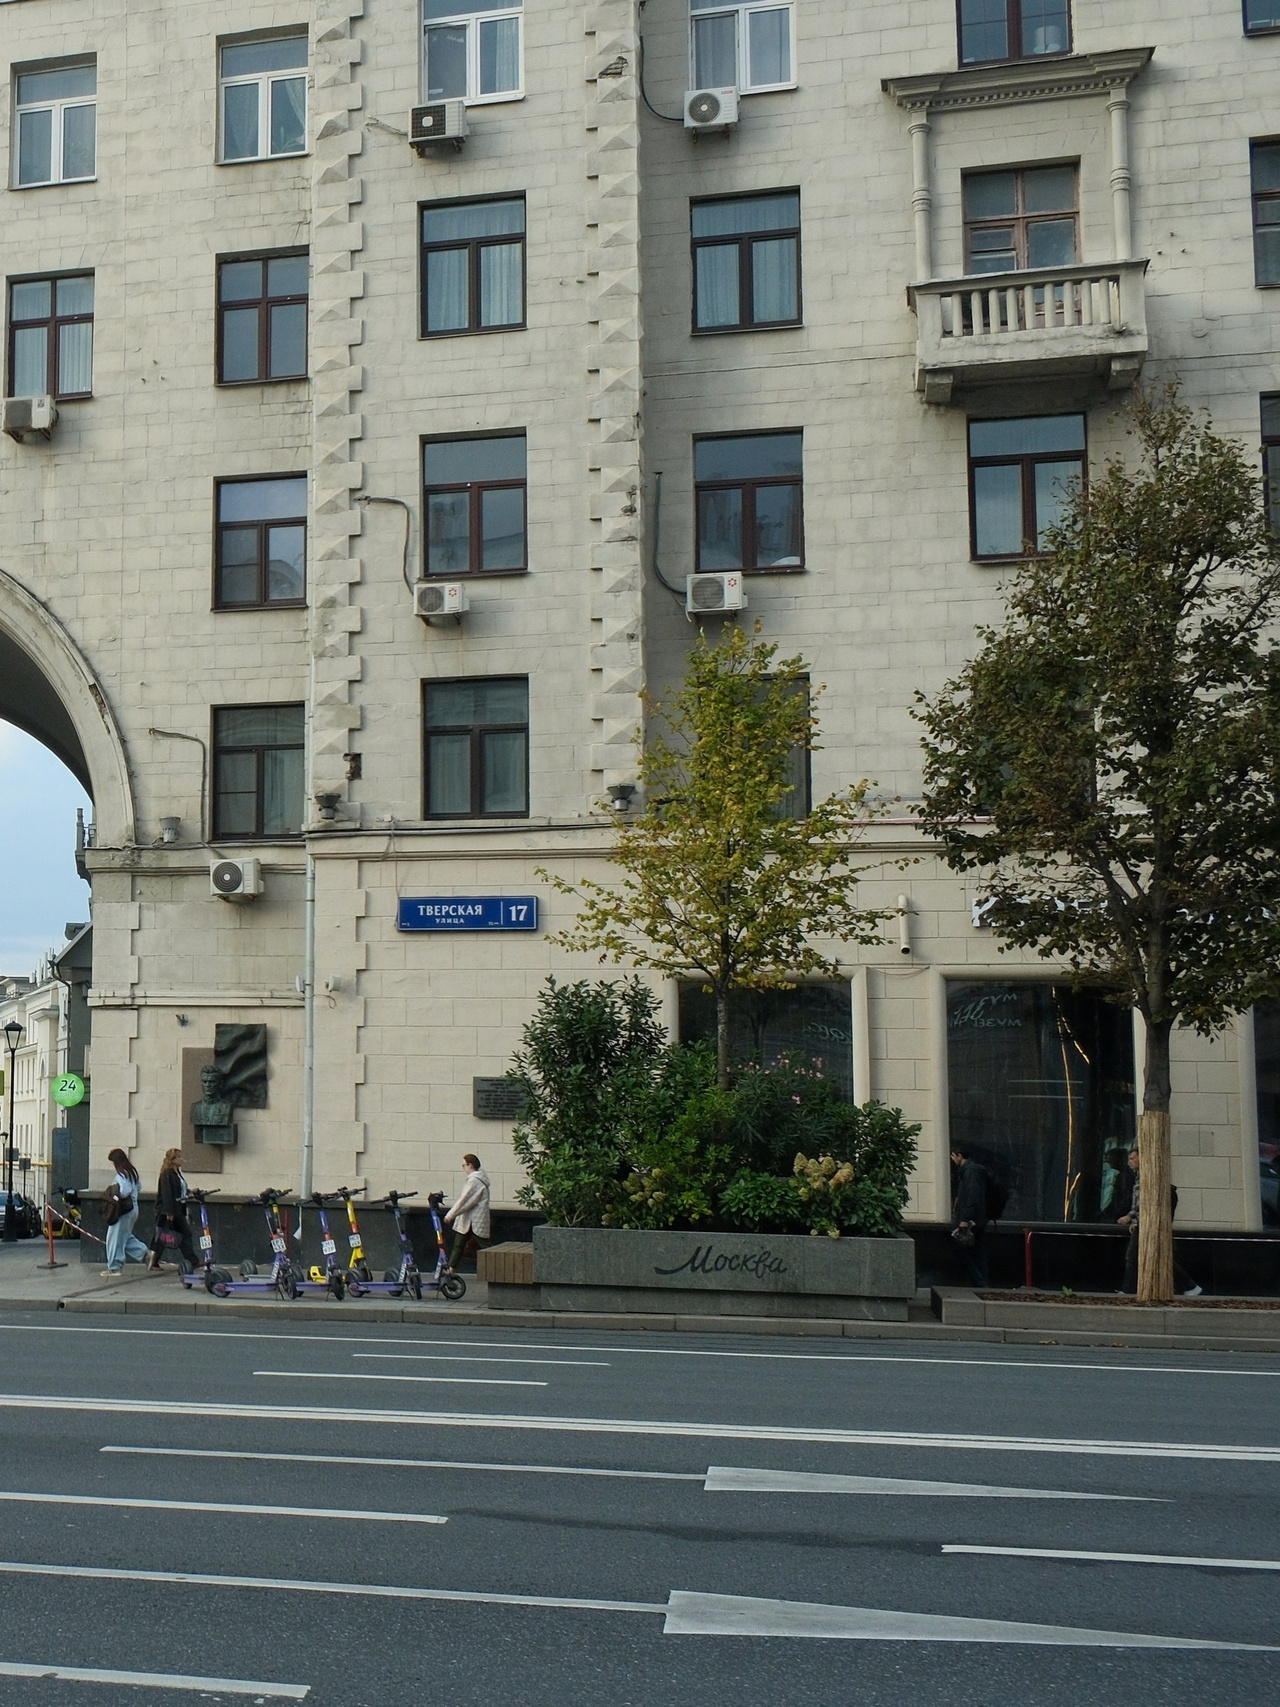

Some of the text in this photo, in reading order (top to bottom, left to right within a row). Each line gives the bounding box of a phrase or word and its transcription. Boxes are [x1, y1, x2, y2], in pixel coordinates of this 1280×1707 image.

[417, 904, 528, 922] ТВЕРСКАЯ 17
[58, 1079, 77, 1092] 24
[653, 1245, 788, 1279] Москва
